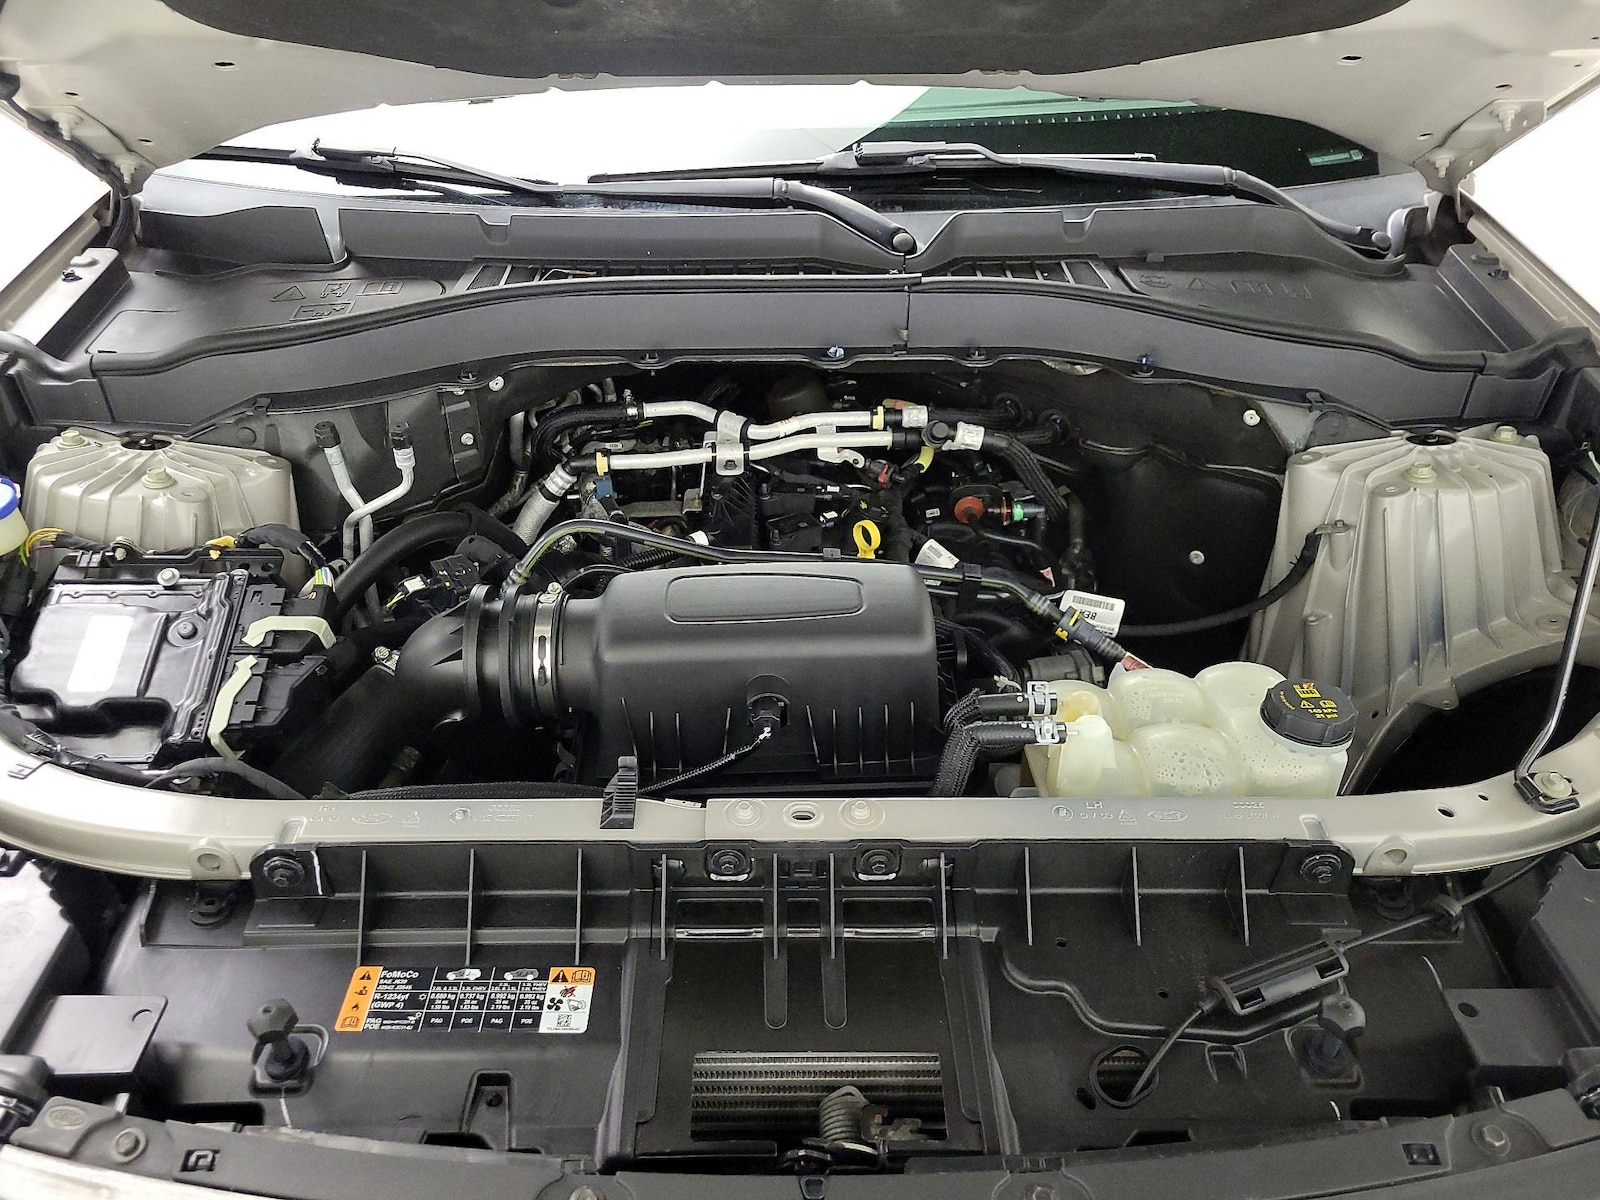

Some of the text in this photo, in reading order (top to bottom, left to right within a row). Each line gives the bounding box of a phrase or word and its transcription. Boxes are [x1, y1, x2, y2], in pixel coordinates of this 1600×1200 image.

[380, 970, 419, 978] FoMoCo
[374, 993, 410, 1001] R-1234yf
[371, 1001, 404, 1009] (GWP 4)
